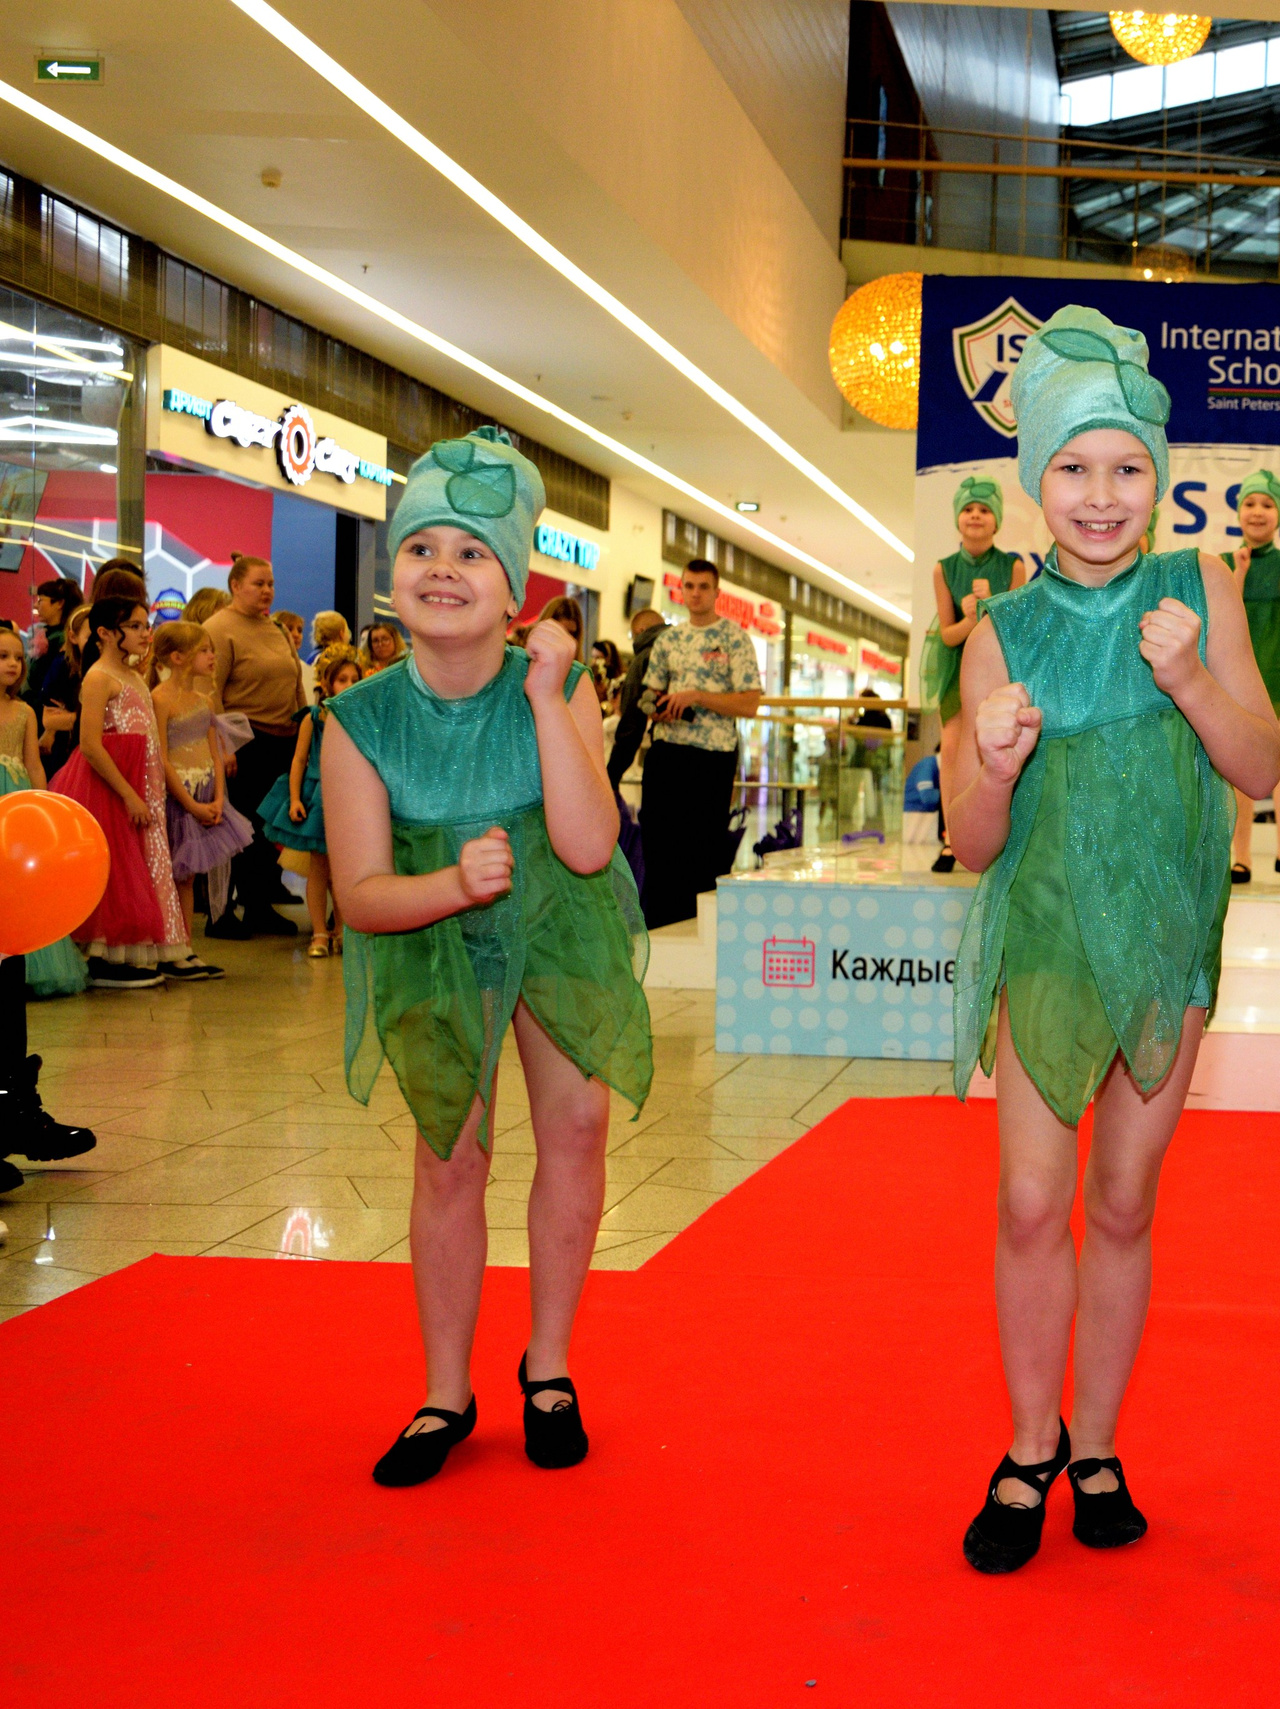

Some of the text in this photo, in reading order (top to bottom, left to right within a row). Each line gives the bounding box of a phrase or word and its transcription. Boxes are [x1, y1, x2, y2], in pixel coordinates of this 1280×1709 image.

[997, 334, 1027, 363] IS
[1207, 396, 1239, 410] Saint
[535, 522, 577, 564] CRAZY
[831, 949, 956, 987] Каждые
